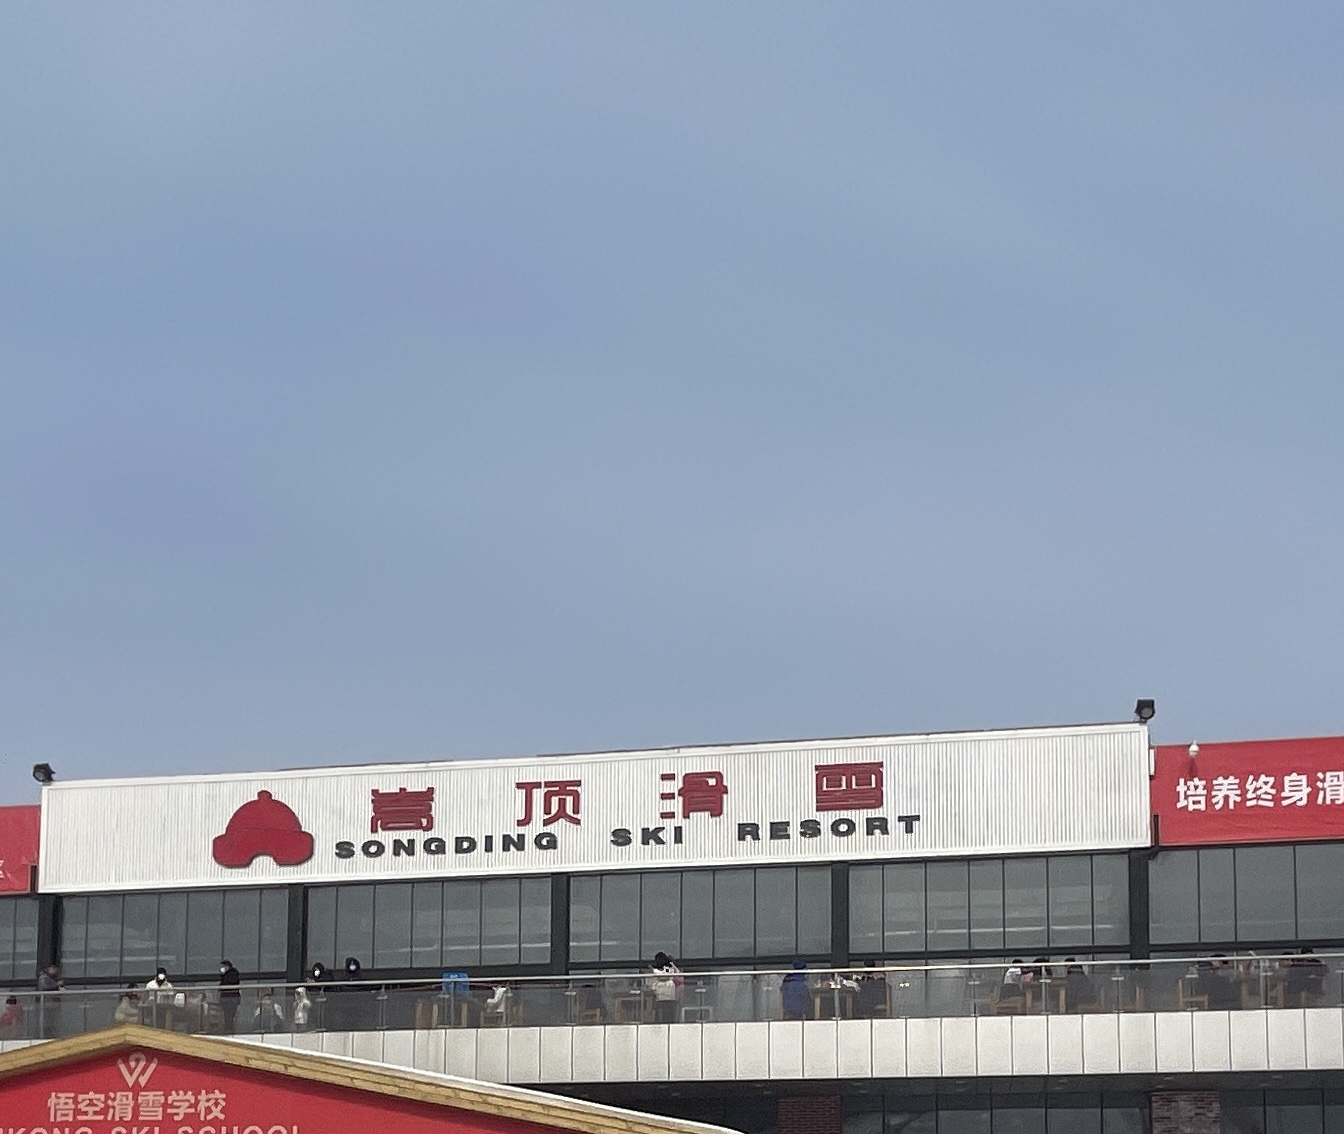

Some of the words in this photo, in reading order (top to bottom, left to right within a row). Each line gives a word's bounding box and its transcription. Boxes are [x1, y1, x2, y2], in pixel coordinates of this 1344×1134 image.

[370, 761, 884, 834] 嵩顶滑雪
[334, 831, 558, 859] SONGDING
[610, 825, 684, 847] SKI
[737, 814, 921, 842] RESORT
[47, 1088, 227, 1123] 悟空滑雪学校
